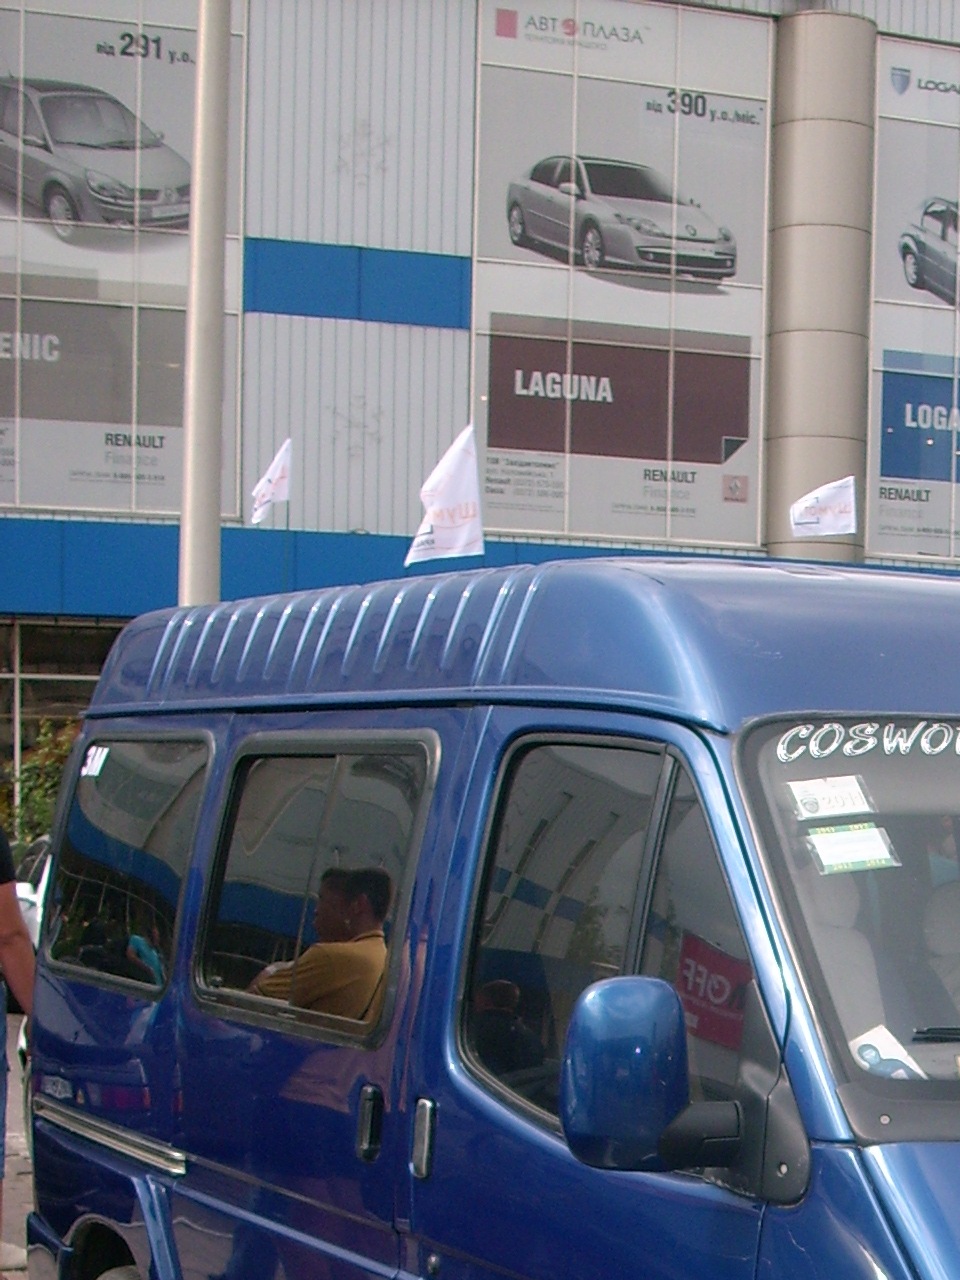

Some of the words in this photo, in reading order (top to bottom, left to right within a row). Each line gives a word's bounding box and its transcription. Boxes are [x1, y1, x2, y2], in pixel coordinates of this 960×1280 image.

[666, 89, 707, 118] 390
[513, 368, 614, 403] LAGUNA
[104, 432, 166, 449] RENAULT
[643, 468, 698, 484] RENAULT
[879, 486, 931, 503] RENAULT
